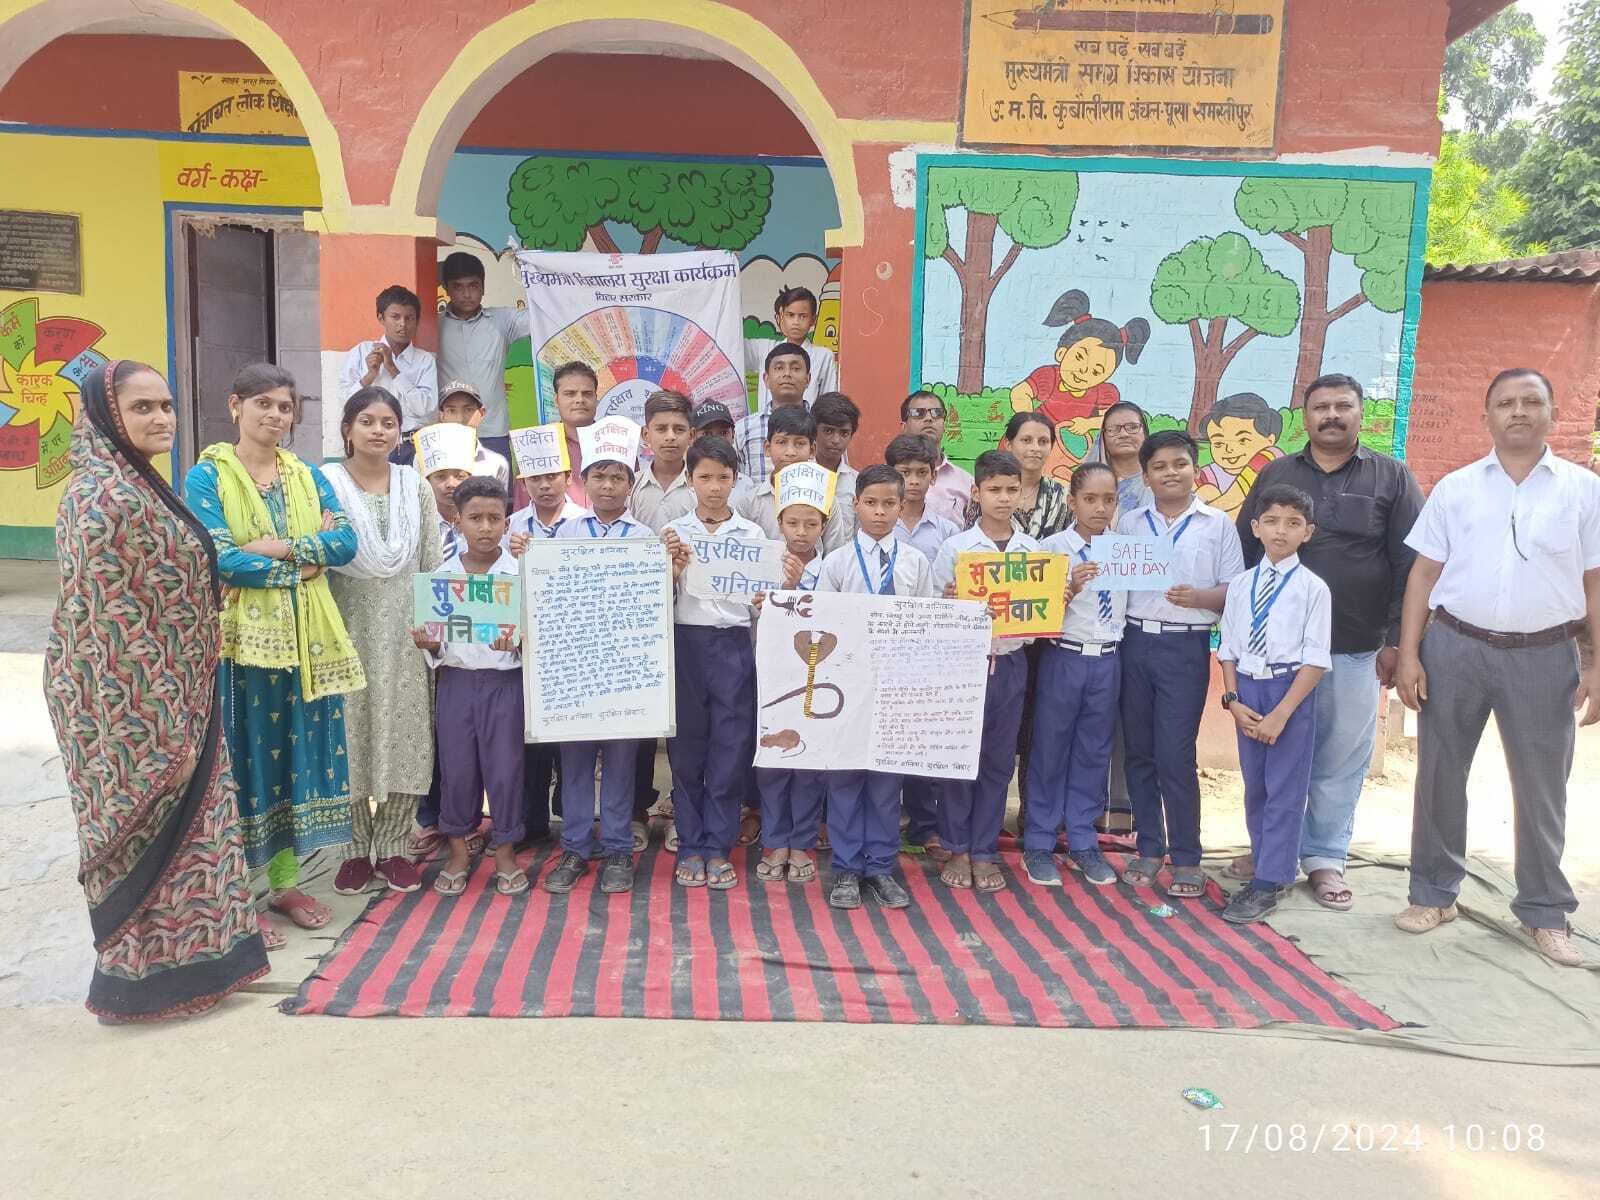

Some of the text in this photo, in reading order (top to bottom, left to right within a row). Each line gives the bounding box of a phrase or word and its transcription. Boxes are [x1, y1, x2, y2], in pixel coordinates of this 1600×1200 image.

[1182, 66, 1235, 89] योजना
[236, 88, 265, 111] लोक
[1008, 101, 1026, 121] म.
[1026, 93, 1047, 120] वि.
[629, 270, 670, 291] सुरक्षा
[674, 262, 737, 283] कार्यक्रम
[619, 292, 653, 303] सरकार
[16, 373, 54, 388] कारक
[20, 390, 49, 406] चिन्ह
[696, 403, 725, 417] KING
[560, 546, 594, 562] सुरक्षित
[693, 537, 764, 564] सुरक्षित
[1112, 542, 1153, 561] SAFE
[967, 552, 1051, 598] सुरक्षित
[431, 574, 514, 617] सुरक्षित
[987, 592, 1050, 624] निवार
